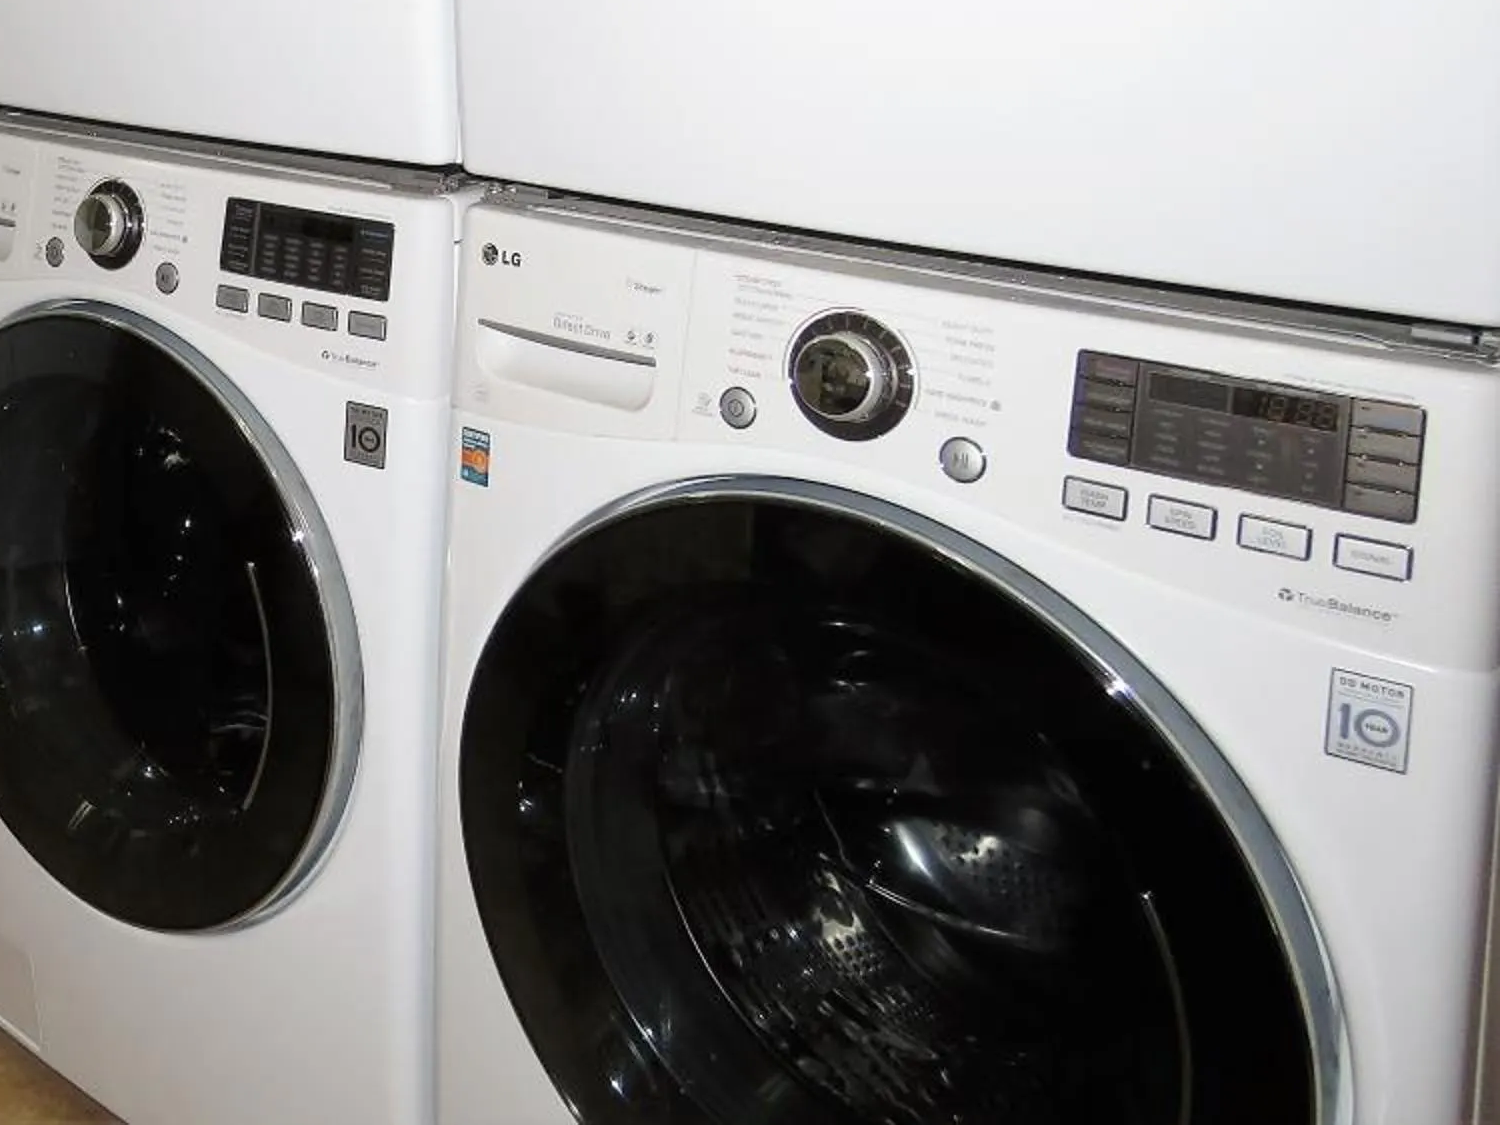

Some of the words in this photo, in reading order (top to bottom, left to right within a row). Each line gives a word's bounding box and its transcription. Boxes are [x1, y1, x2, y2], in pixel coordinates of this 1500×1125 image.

[501, 251, 522, 267] LG
[1360, 681, 1405, 699] MOTOR
[1338, 703, 1402, 748] 10
